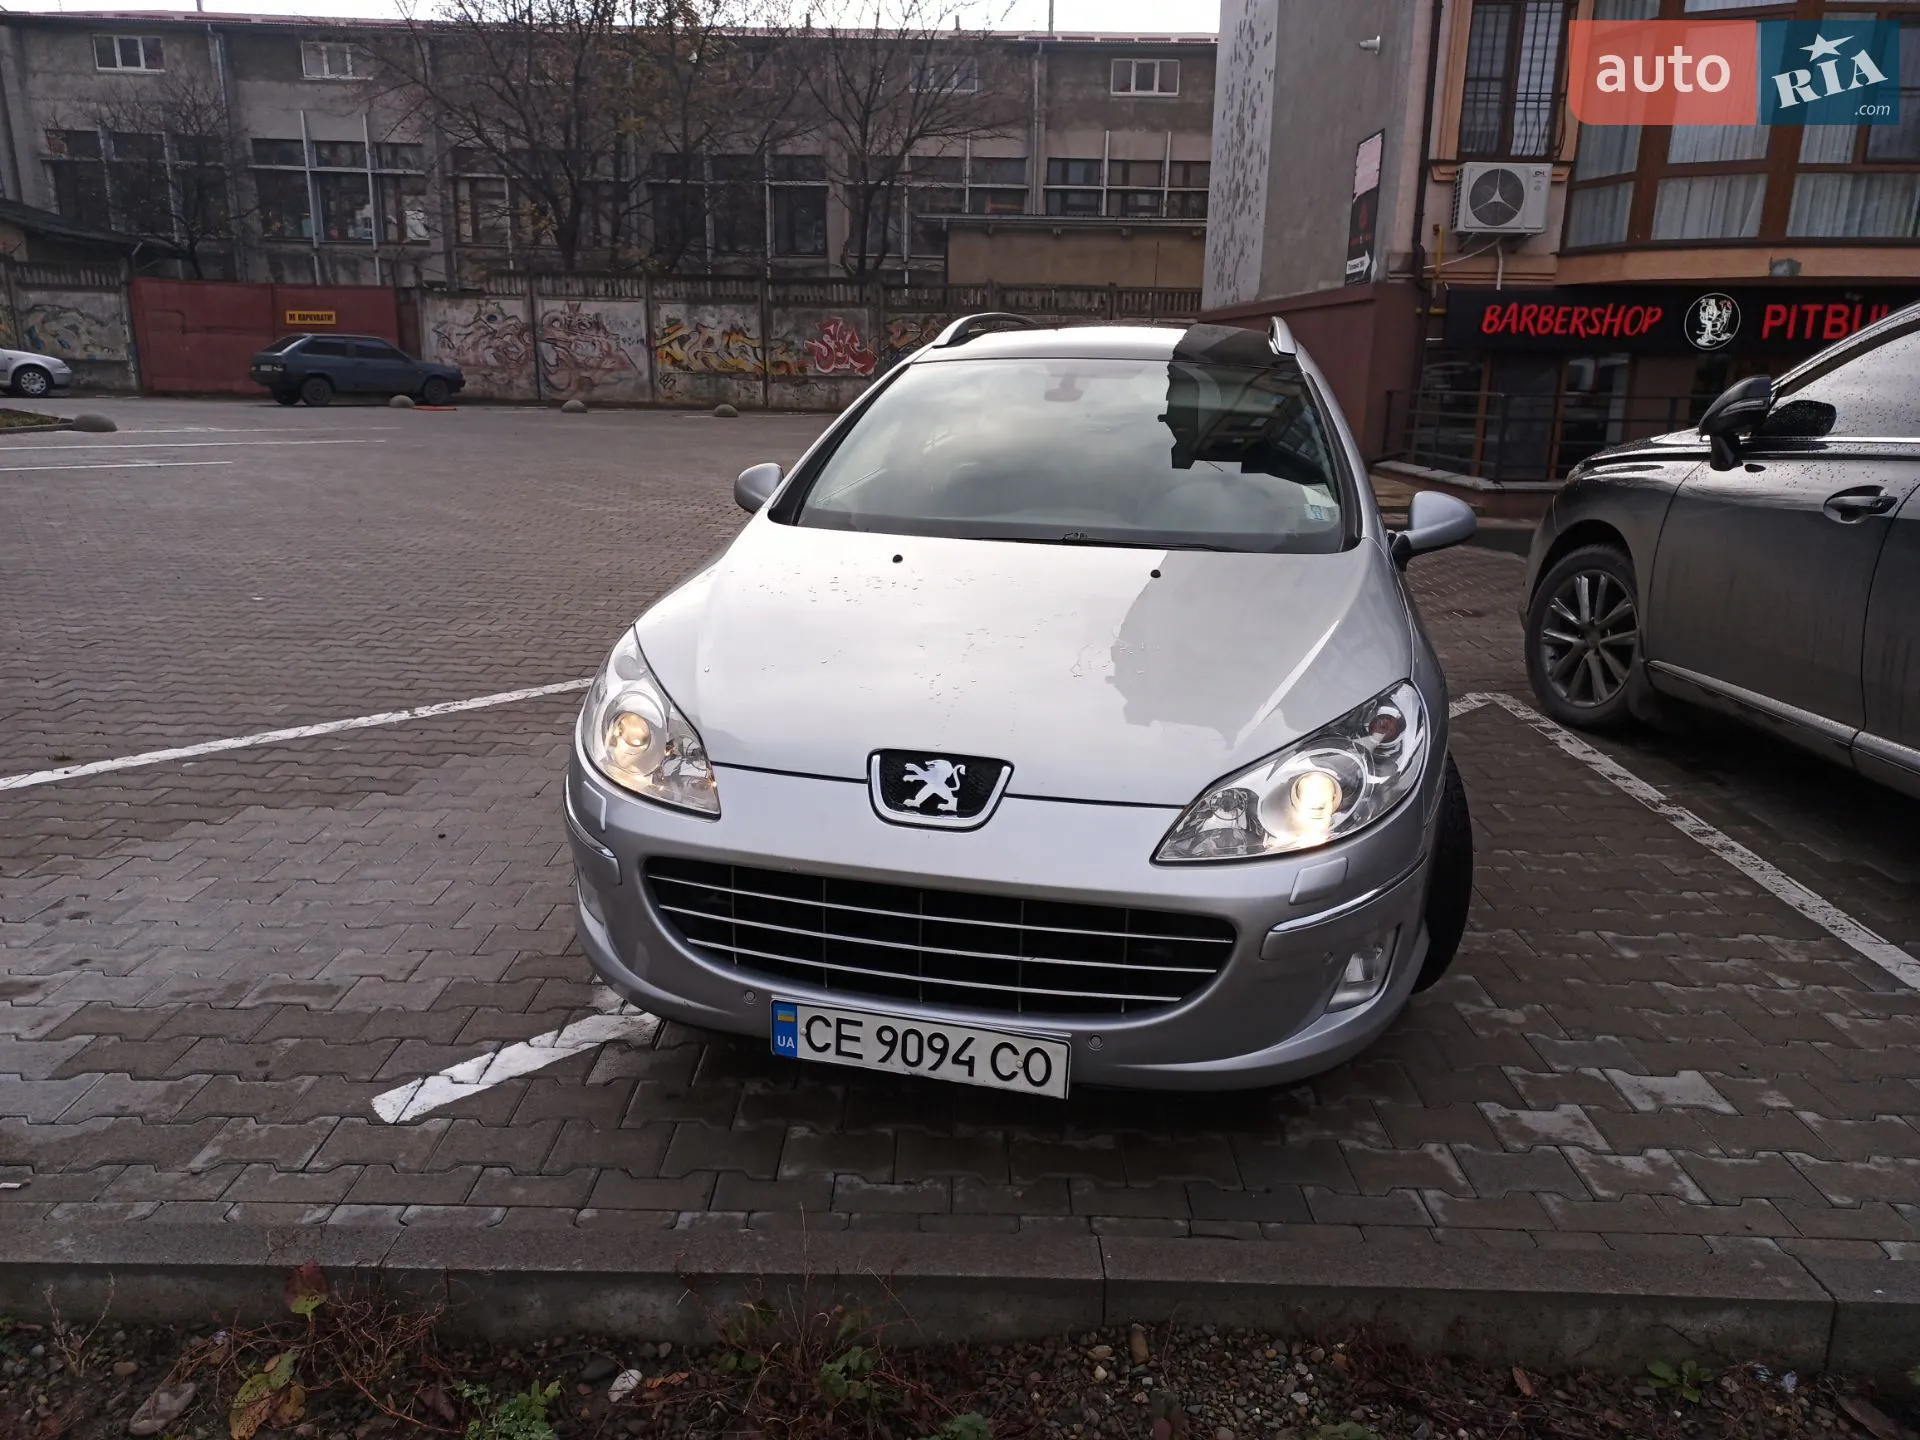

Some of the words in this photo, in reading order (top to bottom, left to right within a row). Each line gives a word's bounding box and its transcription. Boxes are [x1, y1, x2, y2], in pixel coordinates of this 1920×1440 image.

[1481, 302, 1663, 338] BARBERSHOP
[777, 1035, 795, 1049] UA
[805, 1014, 863, 1060] CE
[876, 1024, 976, 1077] 9094
[990, 1042, 1053, 1087] CO
